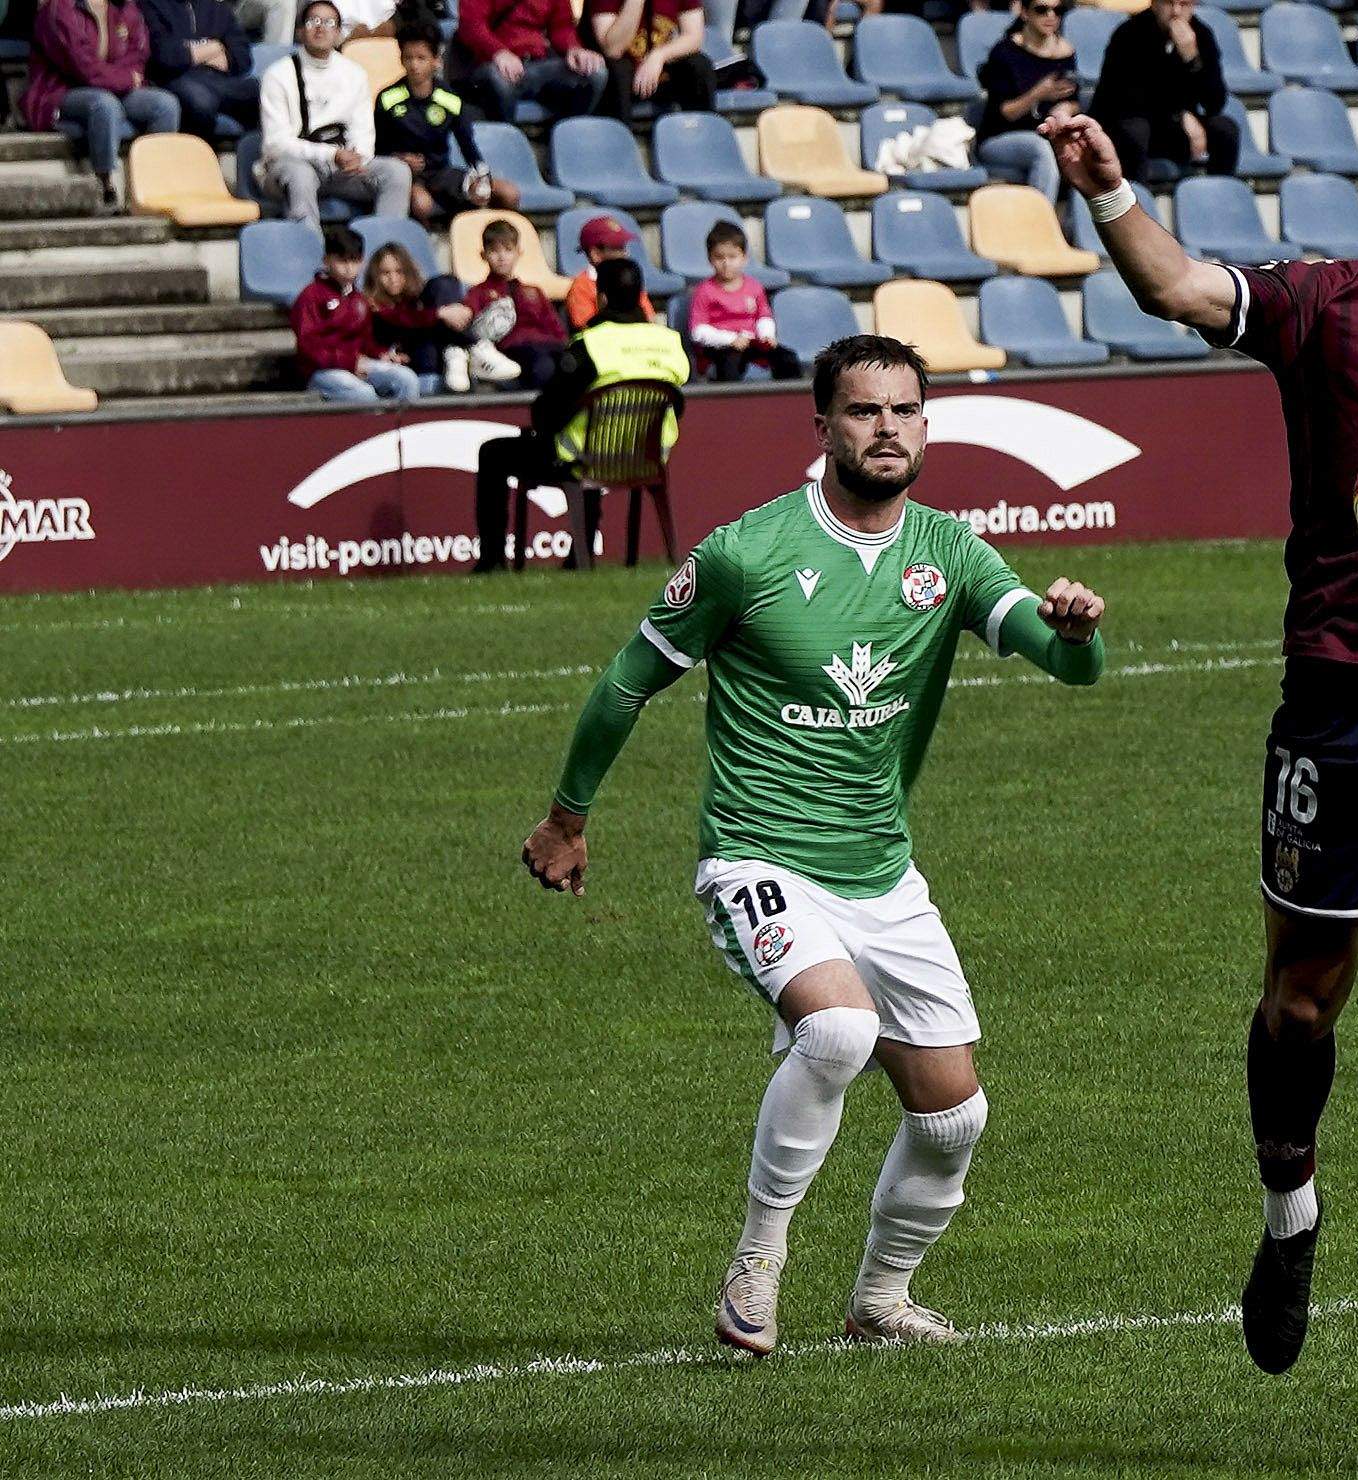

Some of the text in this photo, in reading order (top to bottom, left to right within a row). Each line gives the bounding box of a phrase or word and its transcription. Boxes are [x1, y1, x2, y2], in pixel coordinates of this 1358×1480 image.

[781, 702, 846, 728] CAJA
[1275, 746, 1319, 825] 16
[730, 879, 787, 930] 18
